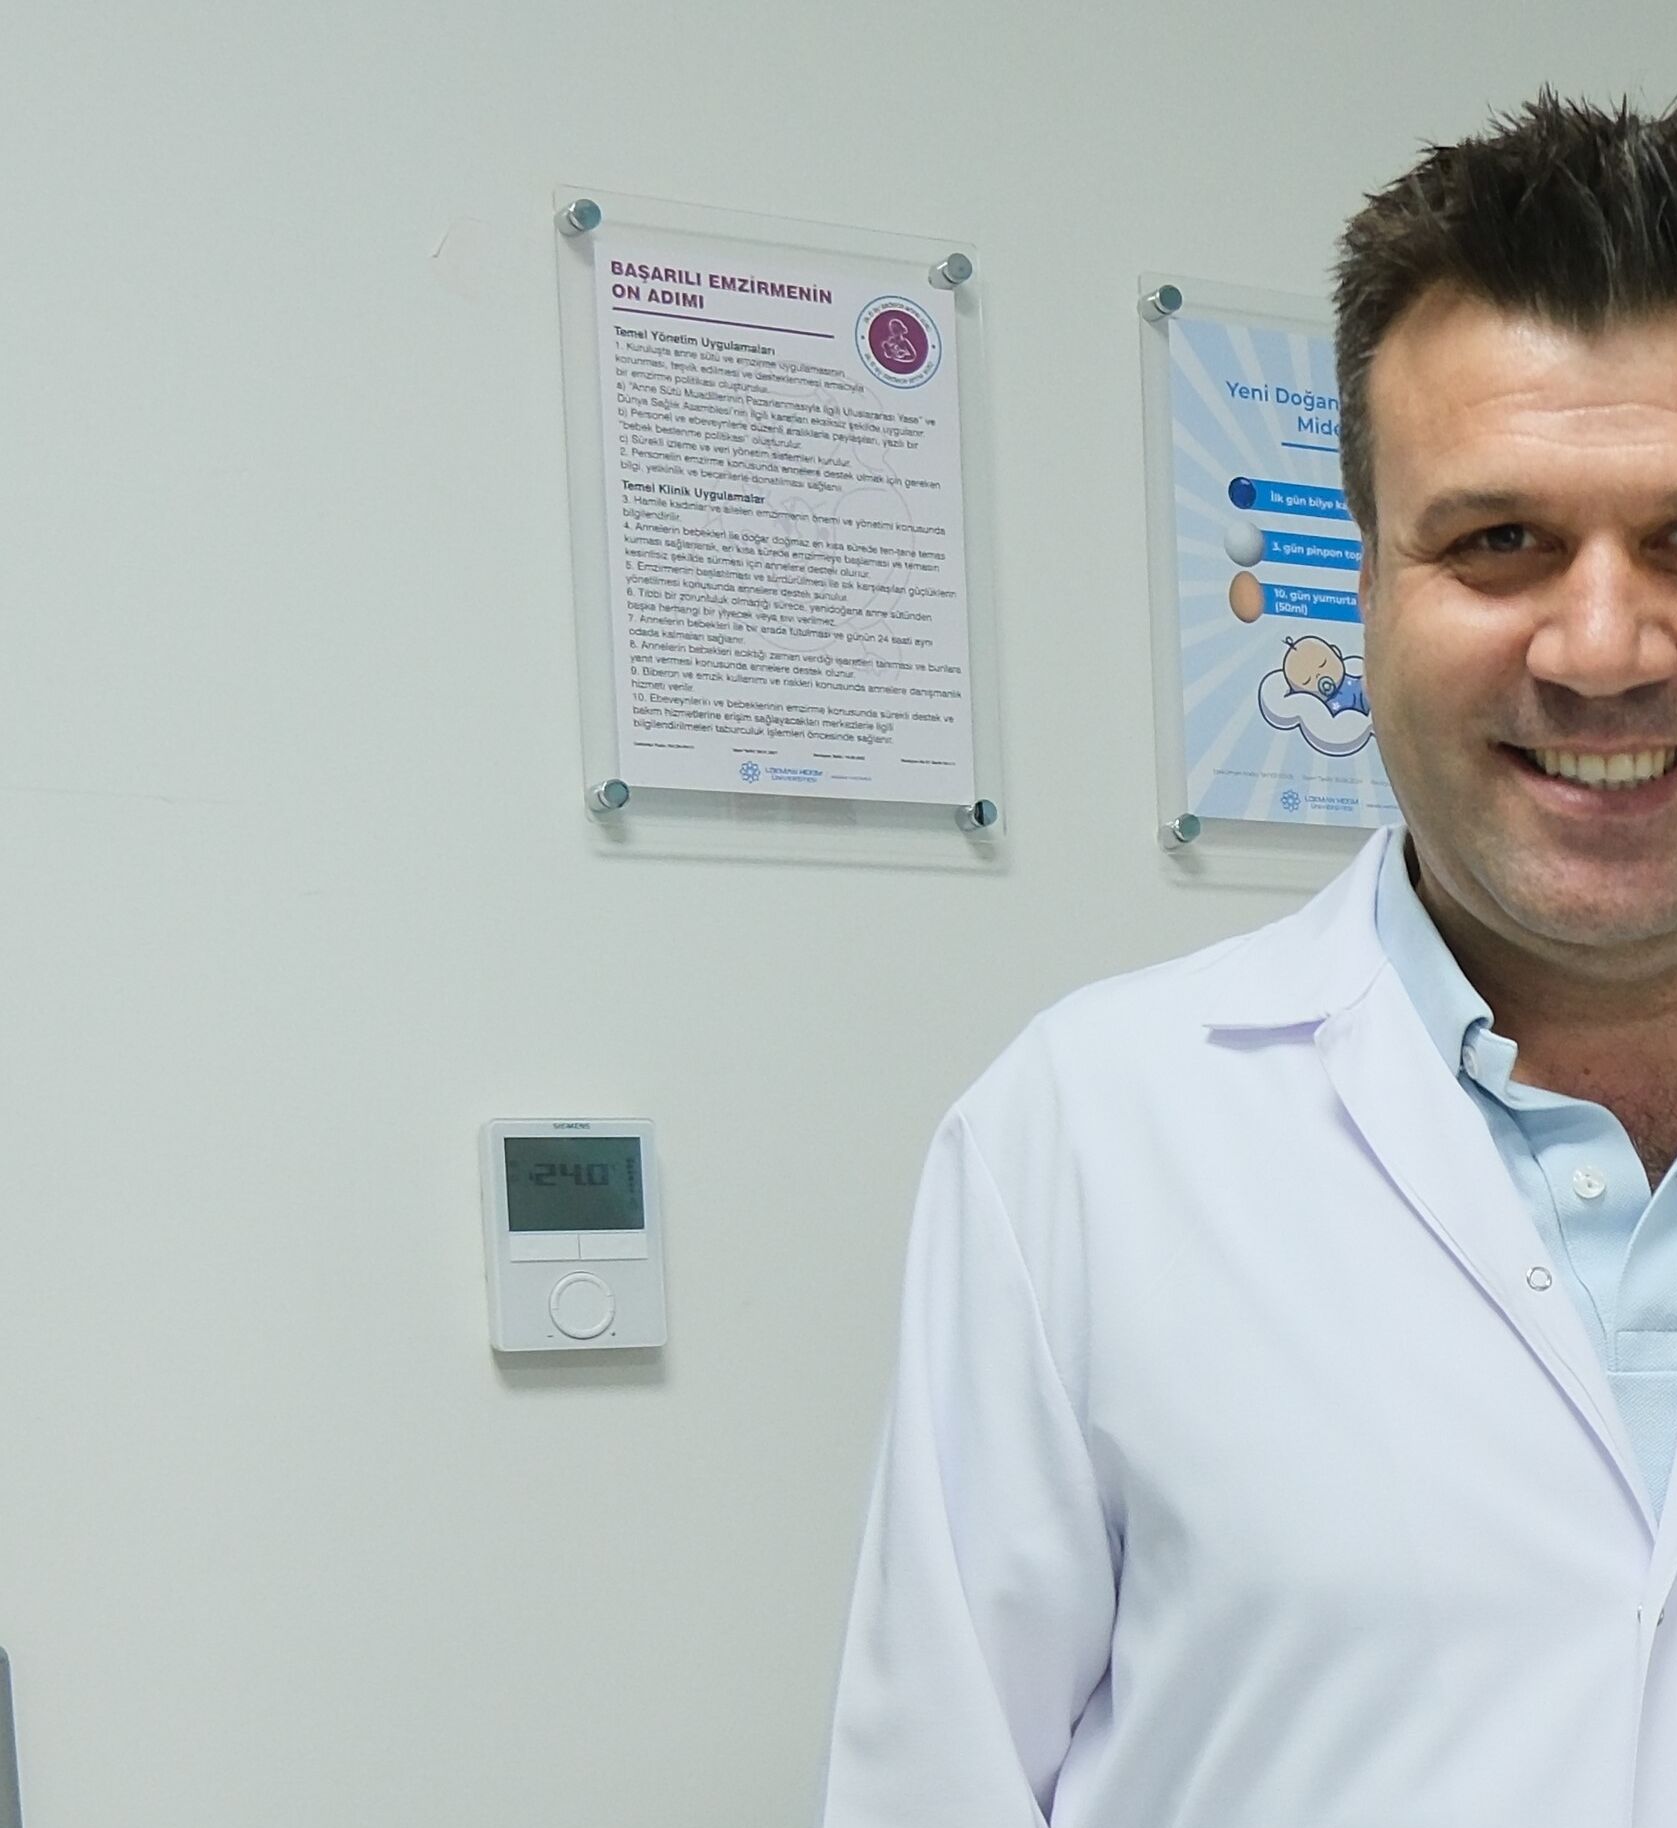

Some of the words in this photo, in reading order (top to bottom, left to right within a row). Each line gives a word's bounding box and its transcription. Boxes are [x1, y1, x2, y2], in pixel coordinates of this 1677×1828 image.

[611, 260, 702, 286] BAŞARILI
[708, 274, 832, 304] EMZİRMENİN
[612, 284, 640, 300] ON
[648, 289, 704, 310] ADIMI
[614, 325, 648, 339] Temel
[651, 329, 698, 345] Yönetim
[700, 335, 776, 358] Uygulamaları
[1226, 380, 1269, 401] Yeni
[1276, 387, 1339, 411] Doğan
[621, 479, 655, 493] Temel
[658, 483, 690, 496] Klinik
[693, 486, 765, 506] Uygulamalar
[1286, 496, 1307, 506] gün
[1283, 543, 1305, 555] gün
[1306, 544, 1343, 557] pinpon
[1345, 549, 1362, 560] top
[1290, 589, 1311, 601] gün
[1313, 593, 1357, 605] yumurta
